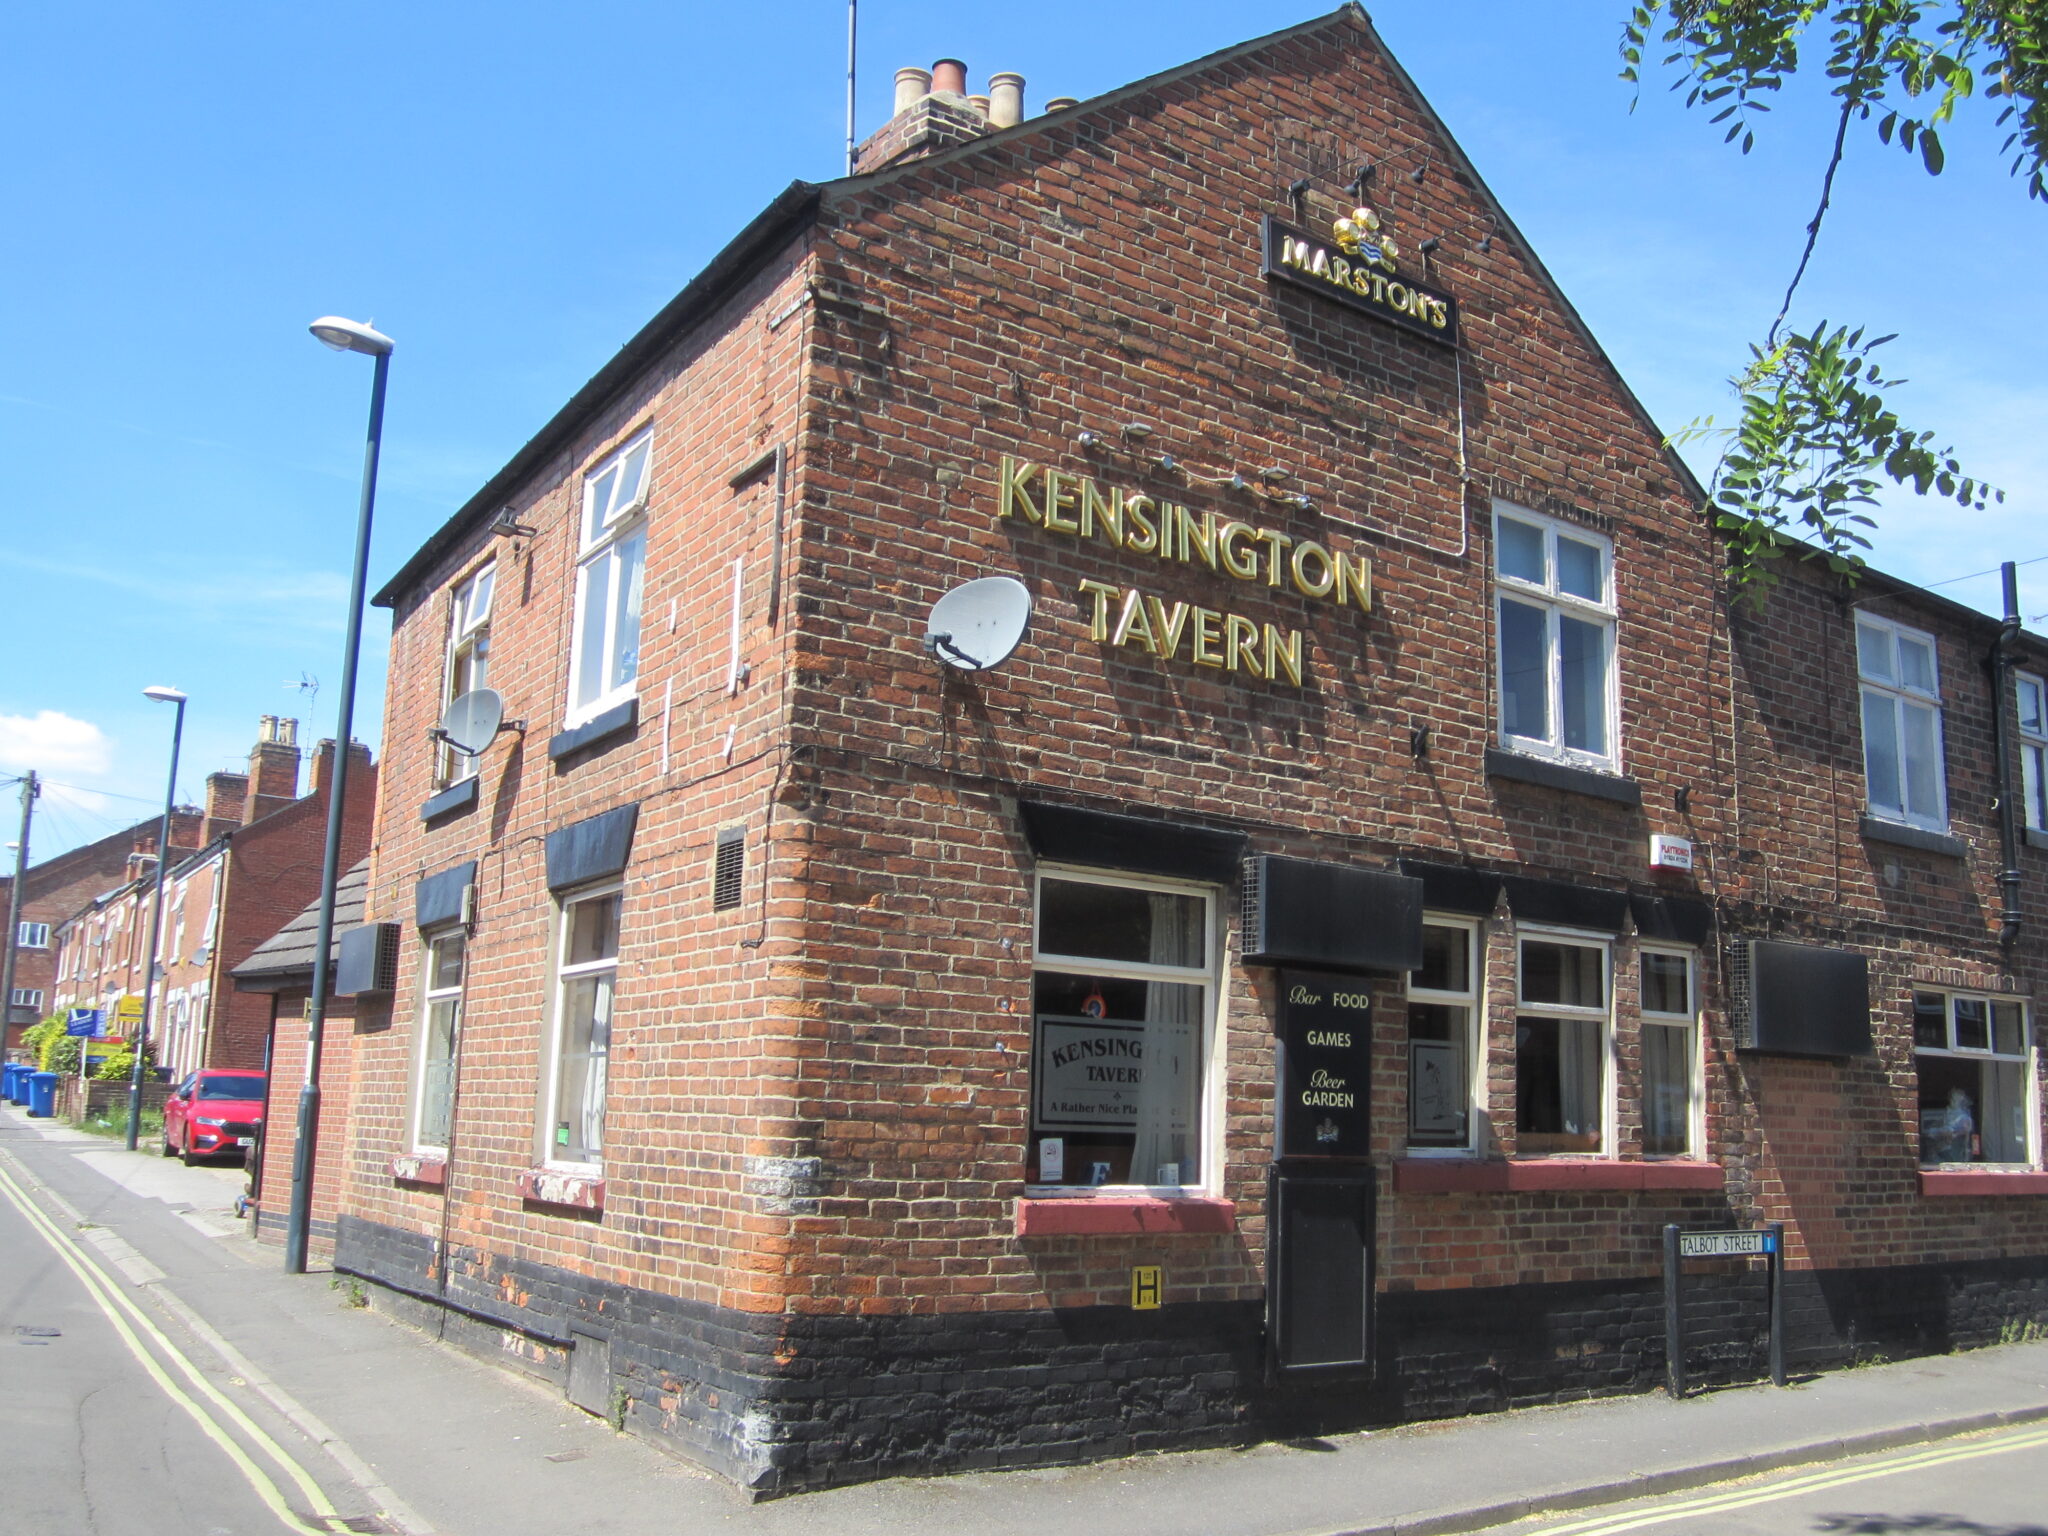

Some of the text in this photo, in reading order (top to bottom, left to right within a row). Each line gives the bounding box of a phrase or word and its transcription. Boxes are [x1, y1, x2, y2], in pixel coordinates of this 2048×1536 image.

[1281, 235, 1447, 329] MARSTON'S
[999, 456, 1372, 613] KENSINGTON
[1079, 579, 1302, 687] TAVERN
[1290, 985, 1369, 1009] Bar FOOD
[1307, 1030, 1351, 1047] GAMES
[1052, 1038, 1143, 1068] KENSING
[1086, 1065, 1143, 1083] TAVER
[1310, 1069, 1345, 1089] Beer
[1051, 1102, 1138, 1115] A Rather Nice Pla
[1302, 1091, 1354, 1108] GARDEN
[1682, 1235, 1758, 1254] TALBOT STREET
[1137, 1270, 1158, 1304] H
